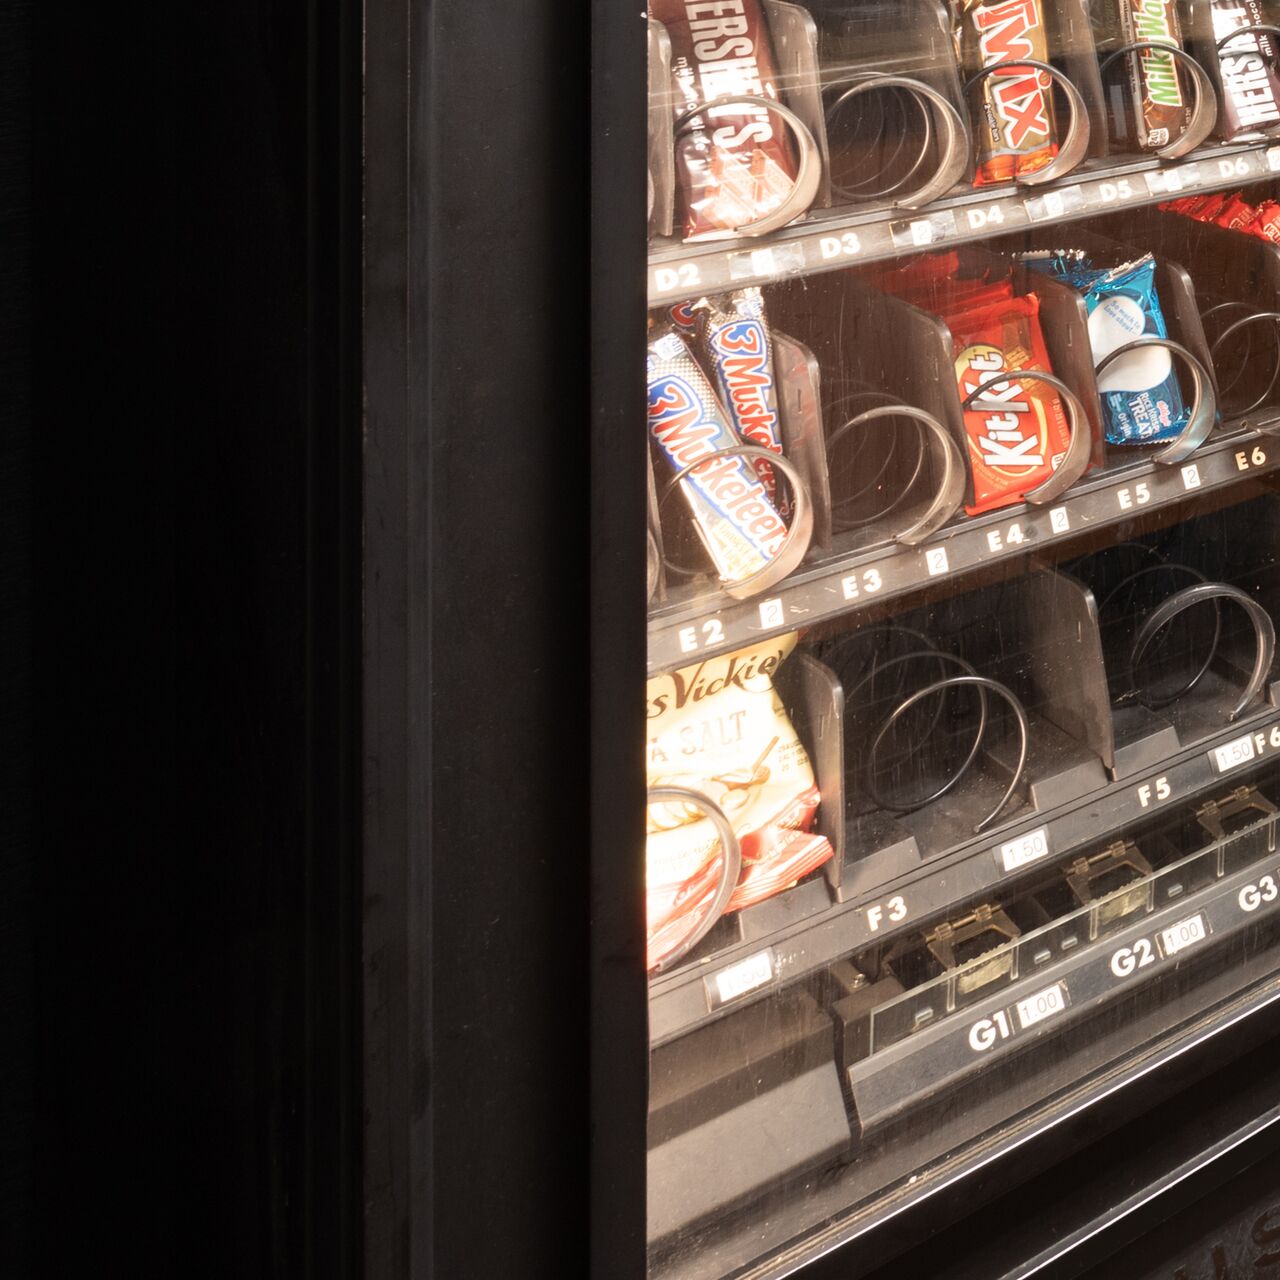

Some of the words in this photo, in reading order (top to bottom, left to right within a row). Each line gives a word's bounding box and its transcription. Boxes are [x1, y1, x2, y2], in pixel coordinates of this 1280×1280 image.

[1262, 34, 1274, 58] milk
[1219, 159, 1250, 178] D6
[1099, 181, 1132, 201] D5
[966, 209, 1004, 230] D4
[819, 233, 861, 259] D3
[655, 263, 701, 292] D2
[718, 324, 757, 354] 3
[1235, 447, 1266, 470] E6
[1185, 469, 1196, 485] 2
[1118, 484, 1151, 510] E5
[1055, 512, 1065, 528] 2
[987, 523, 1023, 552] E4
[932, 552, 944, 571] 2
[842, 572, 882, 600] E3
[765, 604, 778, 623] 2
[679, 620, 724, 652] E2
[682, 710, 748, 757] SALT
[1220, 741, 1251, 766] 1.50
[1138, 777, 1171, 807] F5
[1008, 836, 1043, 861] 1.50
[1238, 876, 1278, 912] G3
[868, 896, 908, 931] F3
[1167, 922, 1198, 950] 1.00
[1110, 938, 1154, 978] G2
[1022, 993, 1057, 1019] 1.00
[969, 1010, 1010, 1052] G1
